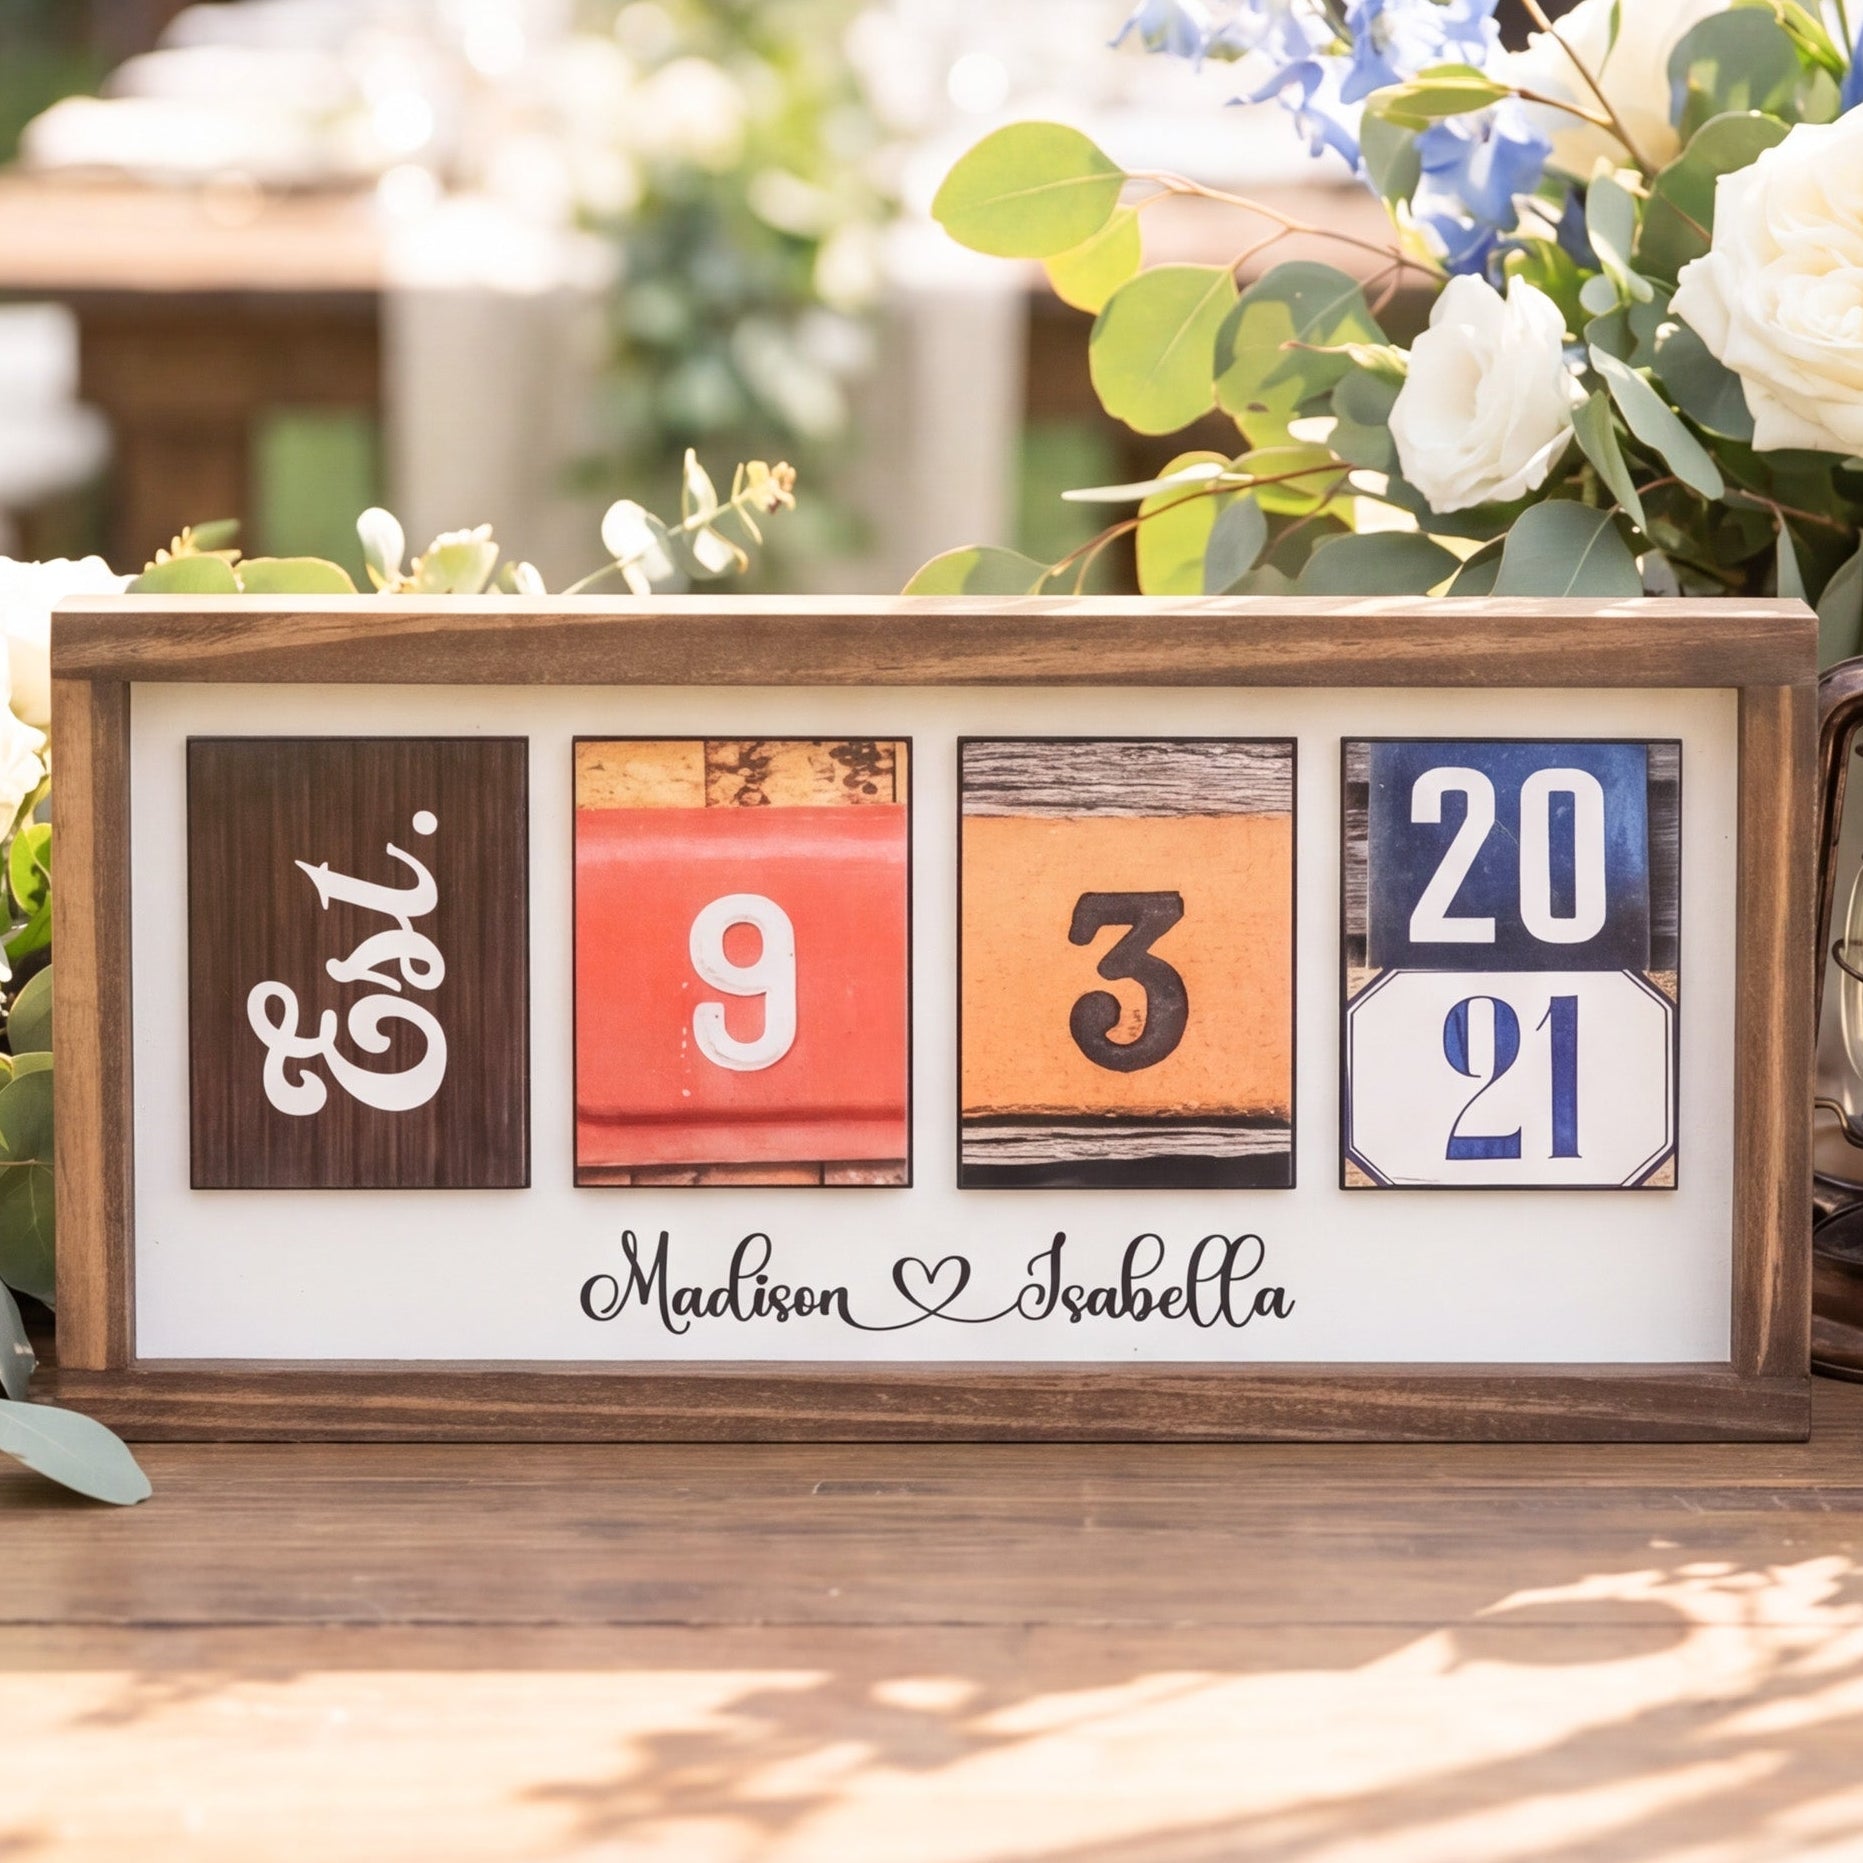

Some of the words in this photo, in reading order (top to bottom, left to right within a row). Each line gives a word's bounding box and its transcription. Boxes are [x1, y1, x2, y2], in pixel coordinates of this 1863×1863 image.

[1409, 766, 1607, 944] 20
[247, 810, 447, 1116] Est.
[689, 892, 797, 1072] 9
[1068, 890, 1190, 1072] 3
[1442, 994, 1583, 1160] 21
[580, 1229, 853, 1335] Madison
[1017, 1231, 1295, 1328] Isabella
